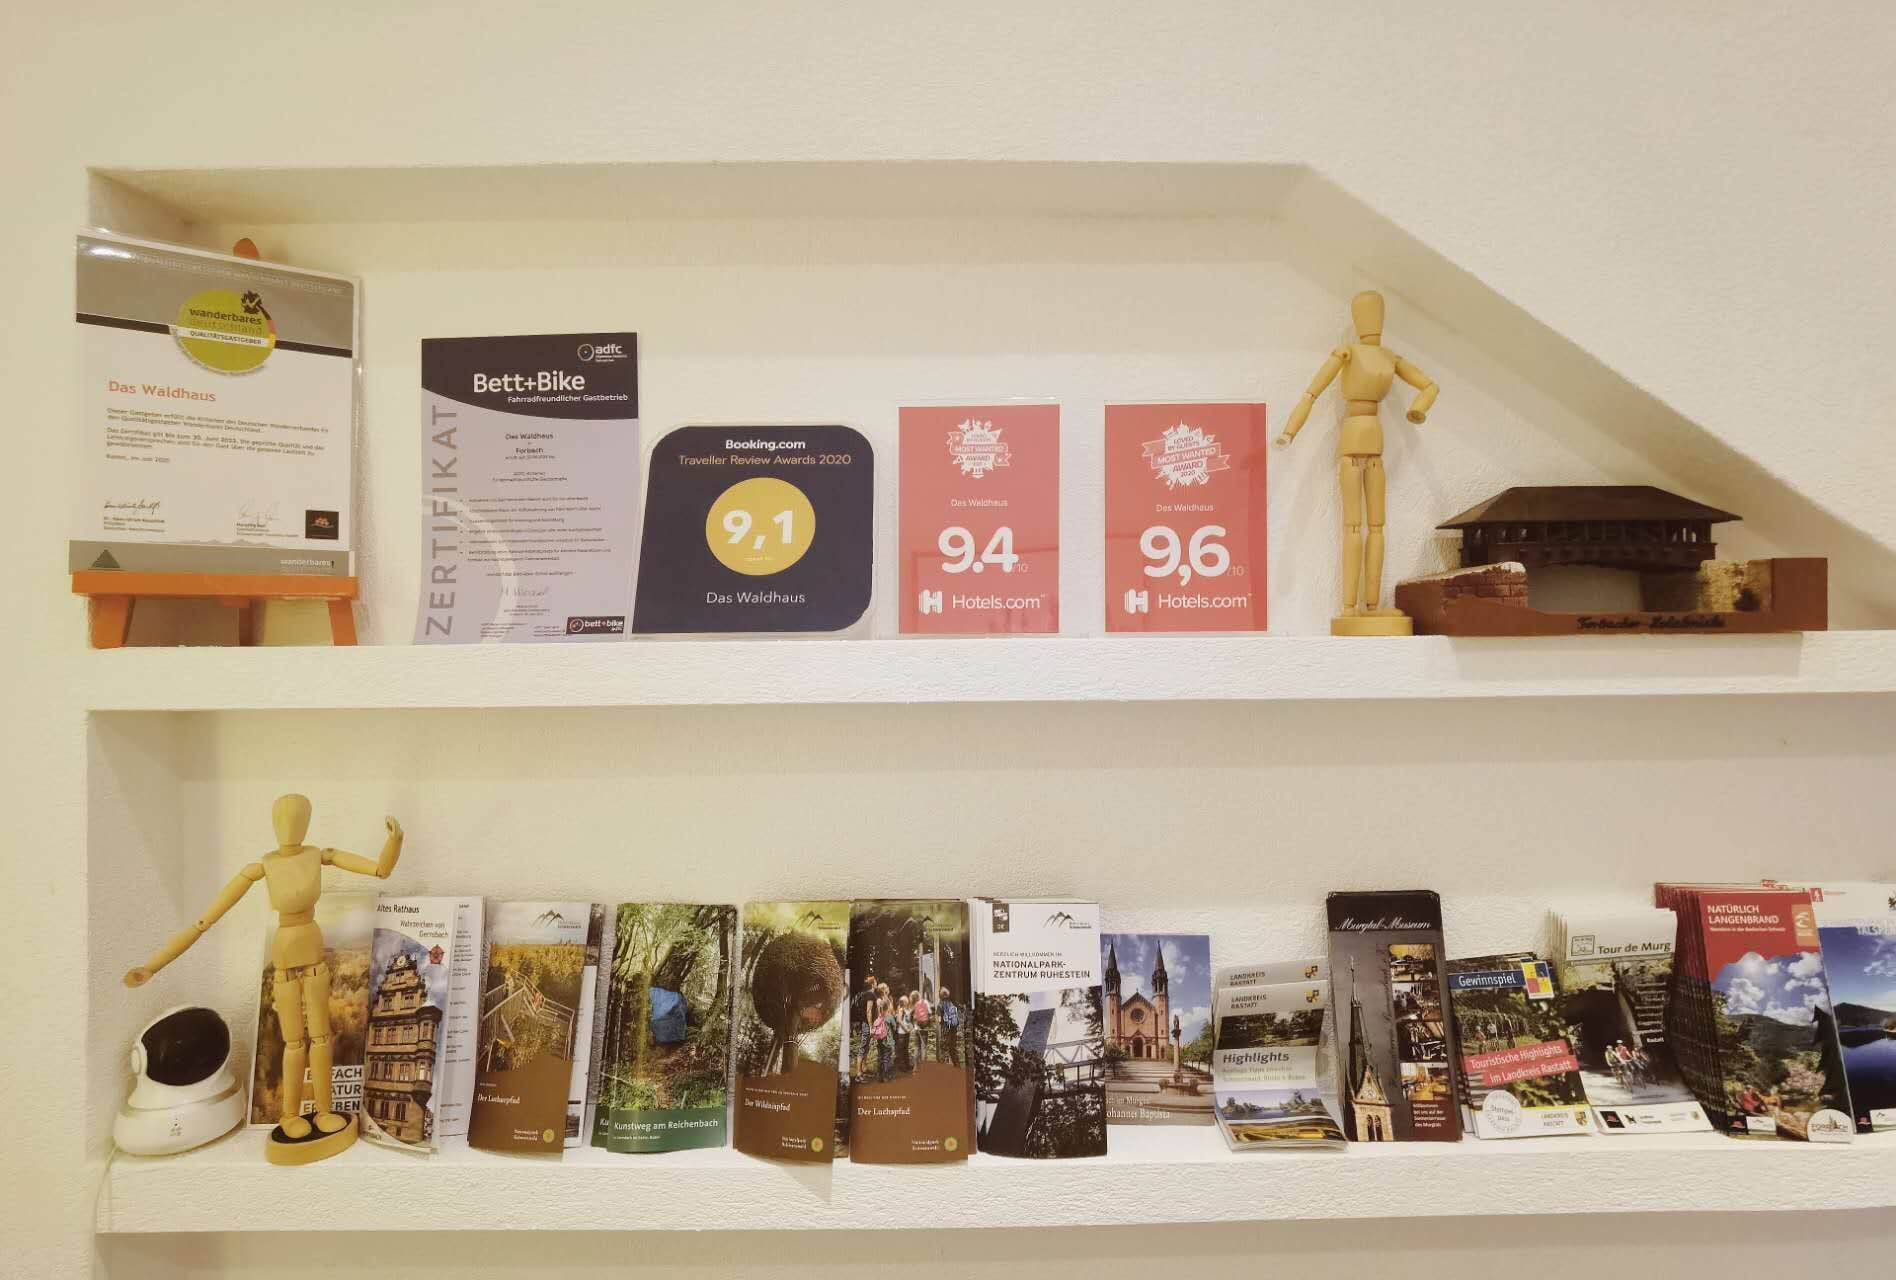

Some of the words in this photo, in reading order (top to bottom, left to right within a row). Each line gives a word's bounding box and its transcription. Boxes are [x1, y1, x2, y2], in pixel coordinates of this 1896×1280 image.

[189, 308, 262, 325] wanderbares
[595, 344, 623, 354] adfc
[473, 370, 586, 394] Bett+Bike
[108, 380, 136, 395] Das
[142, 383, 217, 402] Waldhaus
[507, 394, 582, 404] Fahrradfreundlicher
[582, 393, 629, 403] Gastbetrieb
[725, 439, 806, 451] Booking.com
[679, 454, 727, 465] Traveller
[730, 454, 771, 465] Review
[773, 454, 816, 465] Awards
[819, 454, 852, 465] 2020
[1157, 452, 1181, 465] MOST
[1182, 447, 1217, 460] WANTED
[1172, 460, 1204, 472] AWARD
[950, 499, 967, 508] Das
[968, 499, 1008, 508] Waldhaus
[1156, 503, 1172, 512] Das
[1174, 503, 1215, 512] Waldhaus
[424, 404, 458, 637] ZERTIFIKAT
[722, 509, 794, 551] 9,1
[938, 526, 1019, 574] 9.4
[1139, 525, 1231, 587] 9,6
[706, 592, 733, 604] Das
[736, 591, 806, 604] Waldhaus
[952, 594, 1041, 610] Hotels.com
[1158, 593, 1248, 610] Hotels.com
[393, 903, 420, 914] Rathaus
[1707, 903, 1760, 914] NATÜRLICH
[1335, 917, 1432, 935] Murgtal-Museum
[1708, 915, 1780, 925] LANGENBRAND
[1598, 944, 1622, 955] Tour
[1624, 943, 1639, 953] de
[1641, 941, 1671, 953] Murg
[992, 960, 1067, 969] NATIONALPARK-
[993, 970, 1039, 979] ZENTRUM
[1040, 970, 1091, 979] RUHESTEIN
[1458, 973, 1517, 988] Gewinnspiel
[1223, 1052, 1290, 1065] Highlights
[1470, 1053, 1519, 1070] Touristische
[1519, 1045, 1562, 1062] Highlights
[1501, 1066, 1541, 1082] Landkreis
[1540, 1061, 1572, 1074] Rastatt
[857, 1107, 872, 1116] Der
[1106, 1106, 1138, 1118] ohannes
[614, 1121, 651, 1133] Kunstweg
[653, 1122, 667, 1131] am
[667, 1118, 719, 1130] Reichenbach
